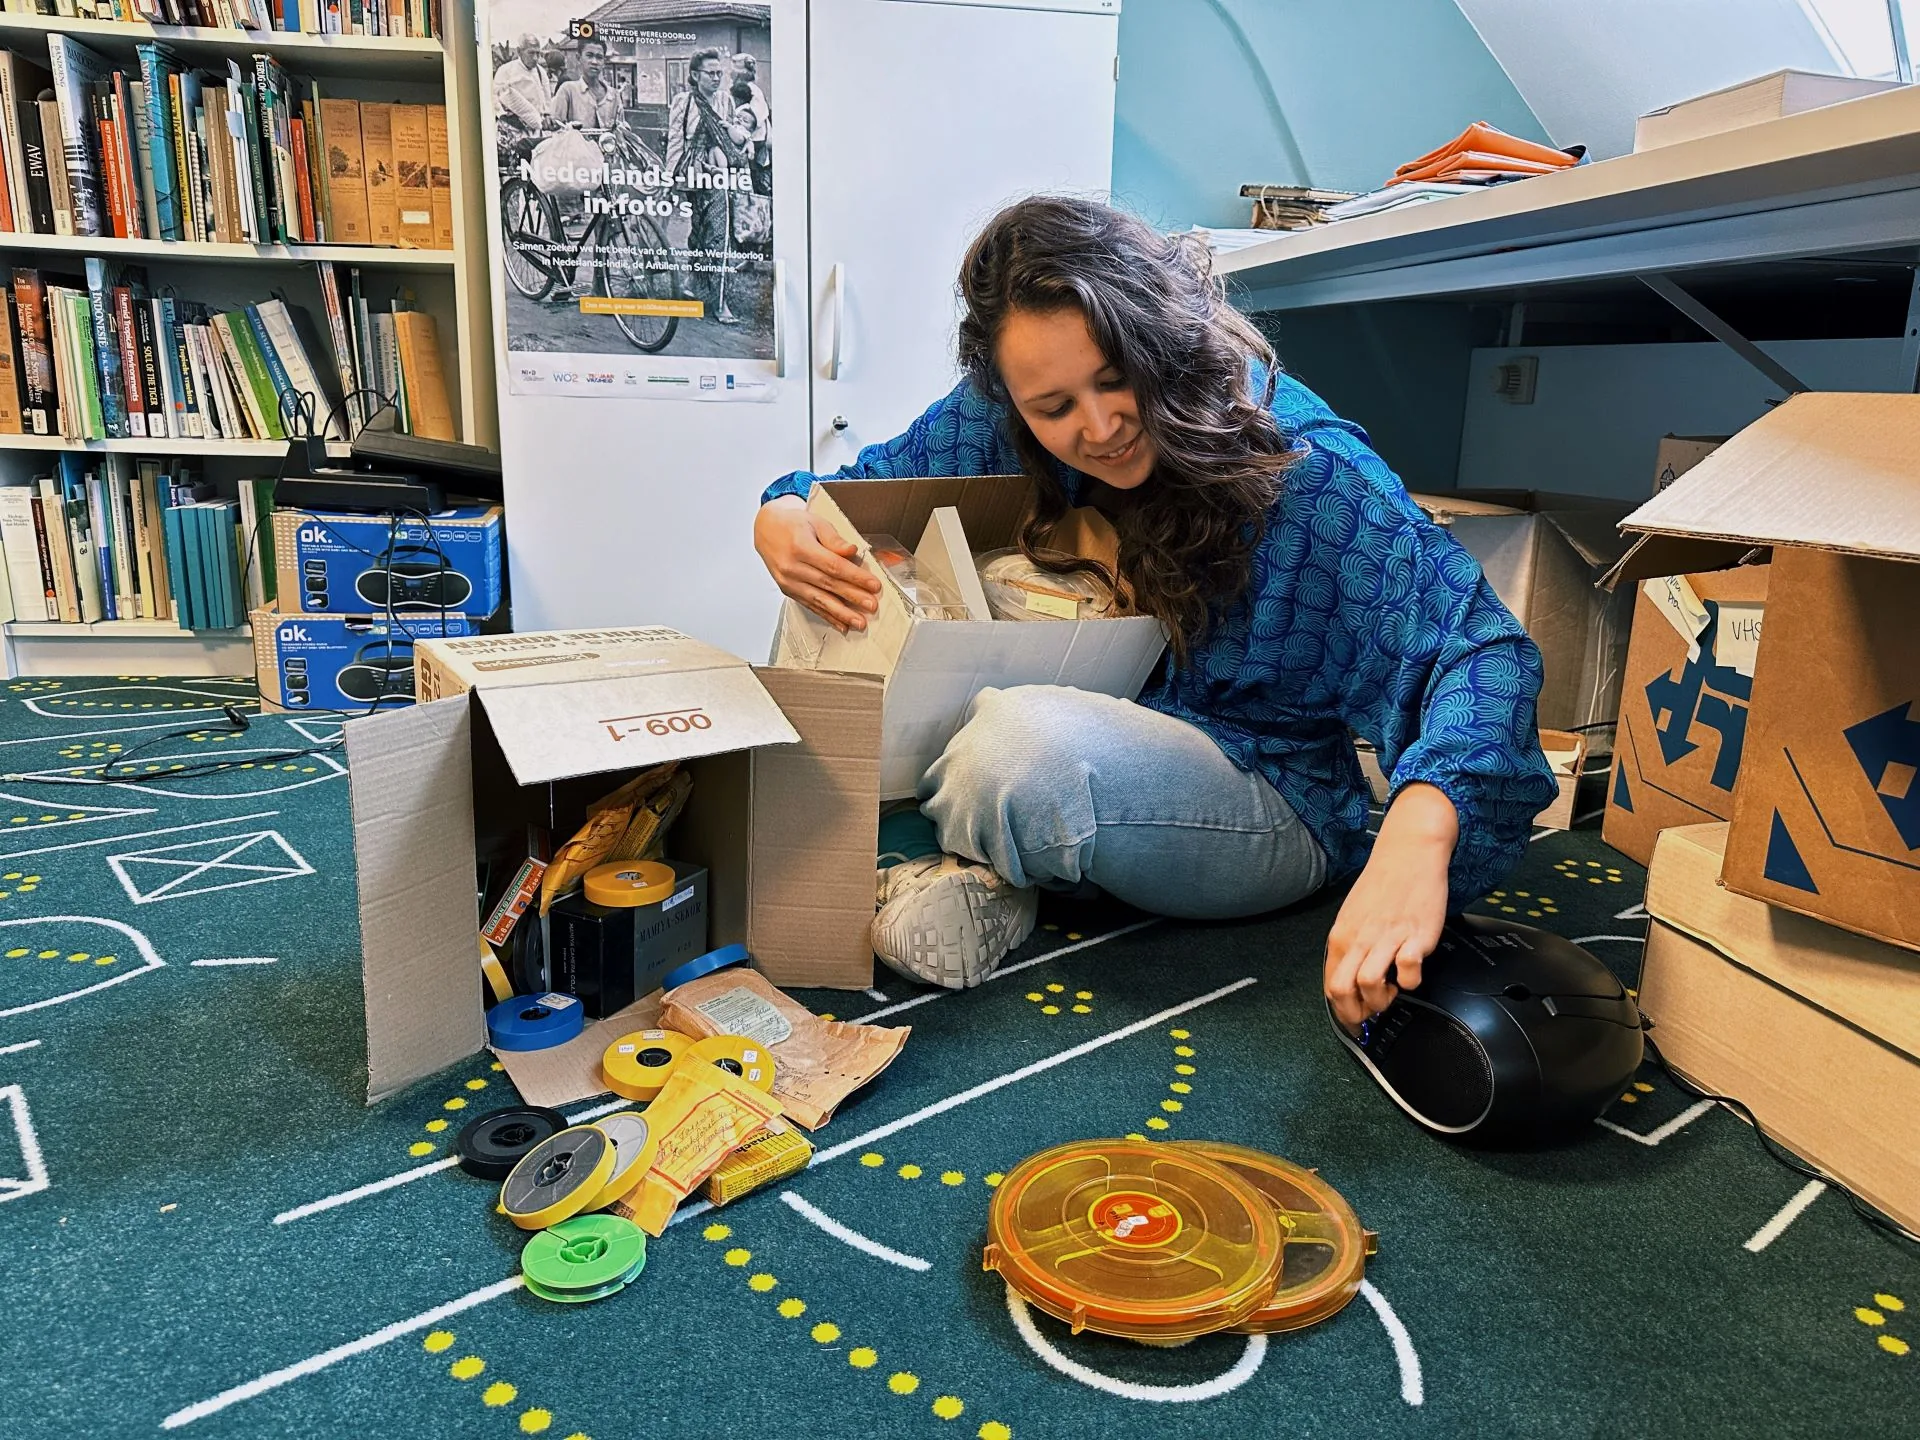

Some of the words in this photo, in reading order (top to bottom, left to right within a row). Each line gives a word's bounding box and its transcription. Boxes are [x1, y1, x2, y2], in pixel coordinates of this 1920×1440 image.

[640, 32, 696, 40] WERELDOORLOG
[141, 59, 153, 104] INDONESIA
[255, 60, 265, 82] TERUG
[257, 82, 266, 92] OP
[518, 158, 753, 191] Nederlands-Indië
[257, 195, 265, 218] BEYOND
[584, 190, 609, 214] in
[618, 194, 693, 218] foto's
[513, 242, 544, 252] Samen
[546, 243, 577, 253] zoeken
[596, 244, 610, 253] het
[612, 246, 636, 254] beeld
[638, 248, 654, 256] van
[656, 247, 668, 256] de
[670, 248, 704, 257] Tweede
[705, 249, 764, 260] Wereldoorlog
[633, 260, 644, 270] de
[646, 261, 680, 270] Antillen
[118, 293, 130, 319] Humid
[164, 300, 174, 321] LAUT
[92, 291, 108, 347] INDONESIË
[121, 319, 134, 348] Tropical
[253, 317, 262, 330] TIM
[258, 330, 274, 357] SEVERIN
[143, 345, 153, 362] SOUL
[177, 344, 190, 375] Tropische
[124, 349, 140, 401] Environments
[145, 363, 154, 373] OF
[553, 374, 579, 382] WO2
[146, 373, 156, 386] THE
[148, 386, 158, 405] TIGER
[301, 526, 332, 544] ok.
[280, 625, 312, 642] ok.
[1732, 619, 1762, 642] VHS
[444, 634, 558, 651] KOEKEN
[455, 644, 538, 656] STUKS
[433, 672, 442, 698] 12
[506, 885, 520, 902] MICRO
[639, 902, 702, 943] MAMIYA-SEKOR
[568, 947, 577, 973] CAMERA
